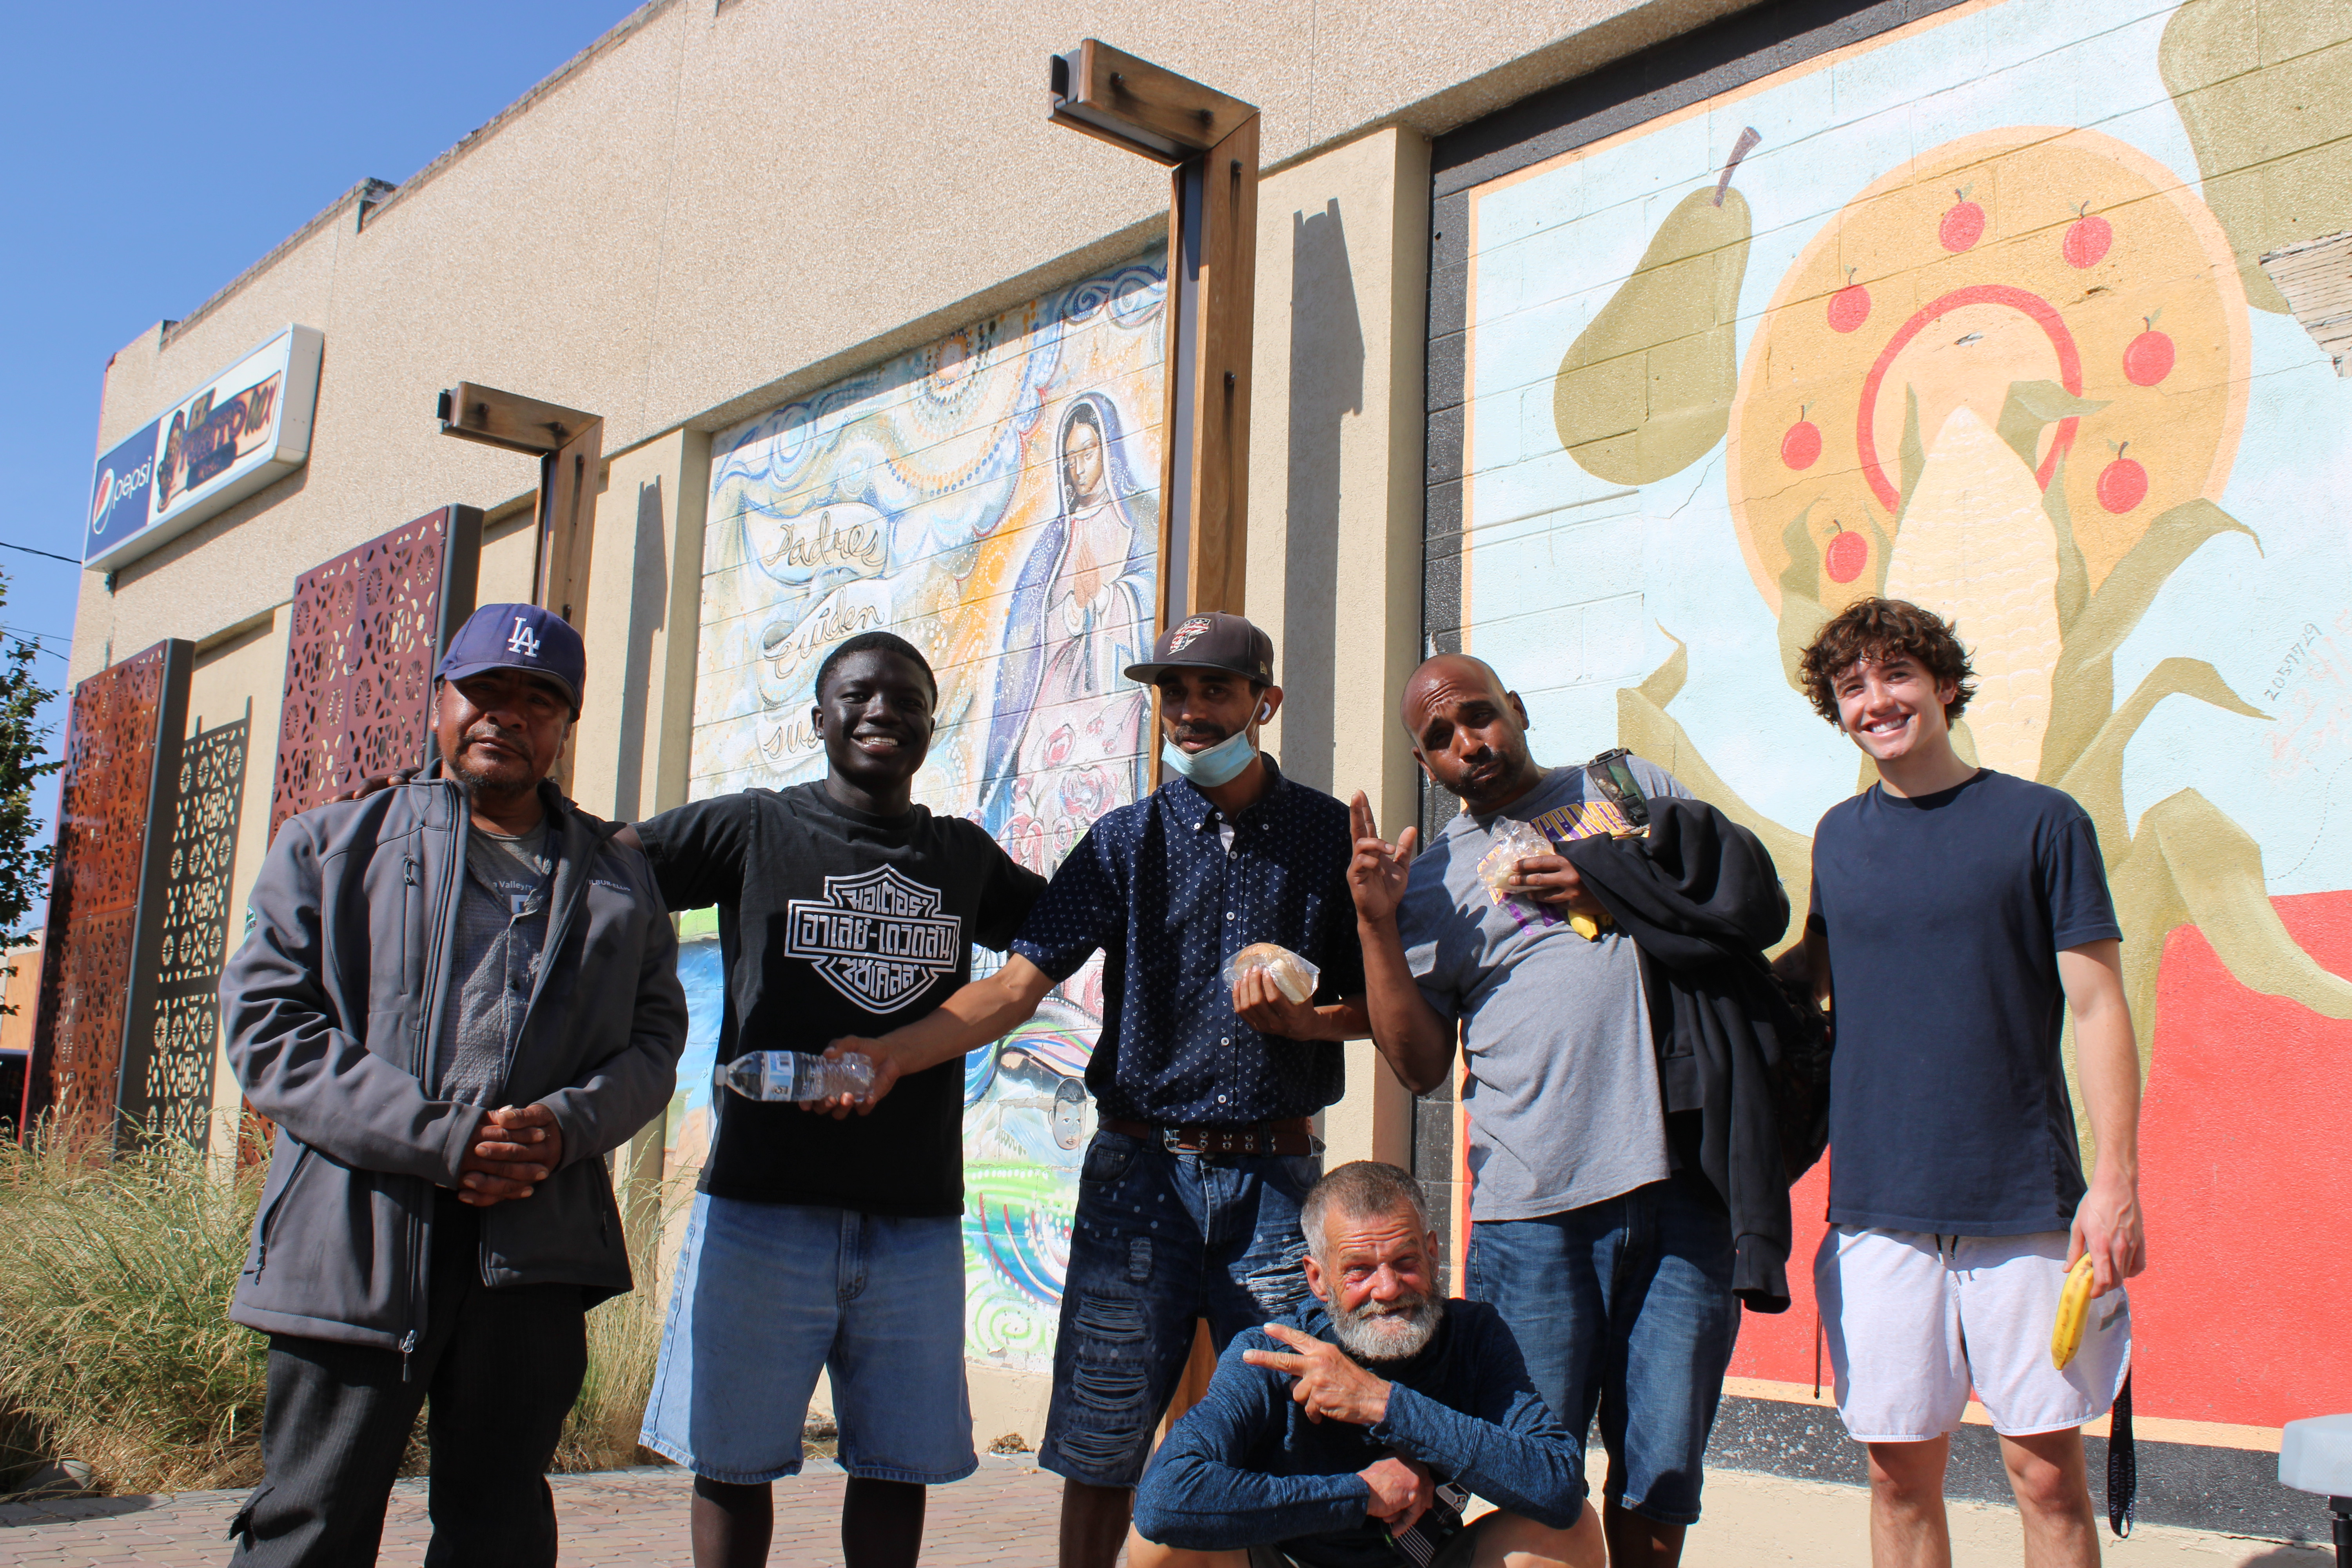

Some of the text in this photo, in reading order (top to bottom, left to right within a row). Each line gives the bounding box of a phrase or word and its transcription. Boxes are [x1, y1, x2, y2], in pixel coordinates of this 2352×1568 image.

[112, 455, 152, 509] pepsi
[508, 617, 540, 657] LA
[499, 881, 524, 890] Valley
[589, 880, 631, 891] ILBUR-ELLIS
[2110, 1453, 2120, 1494] CANYON
